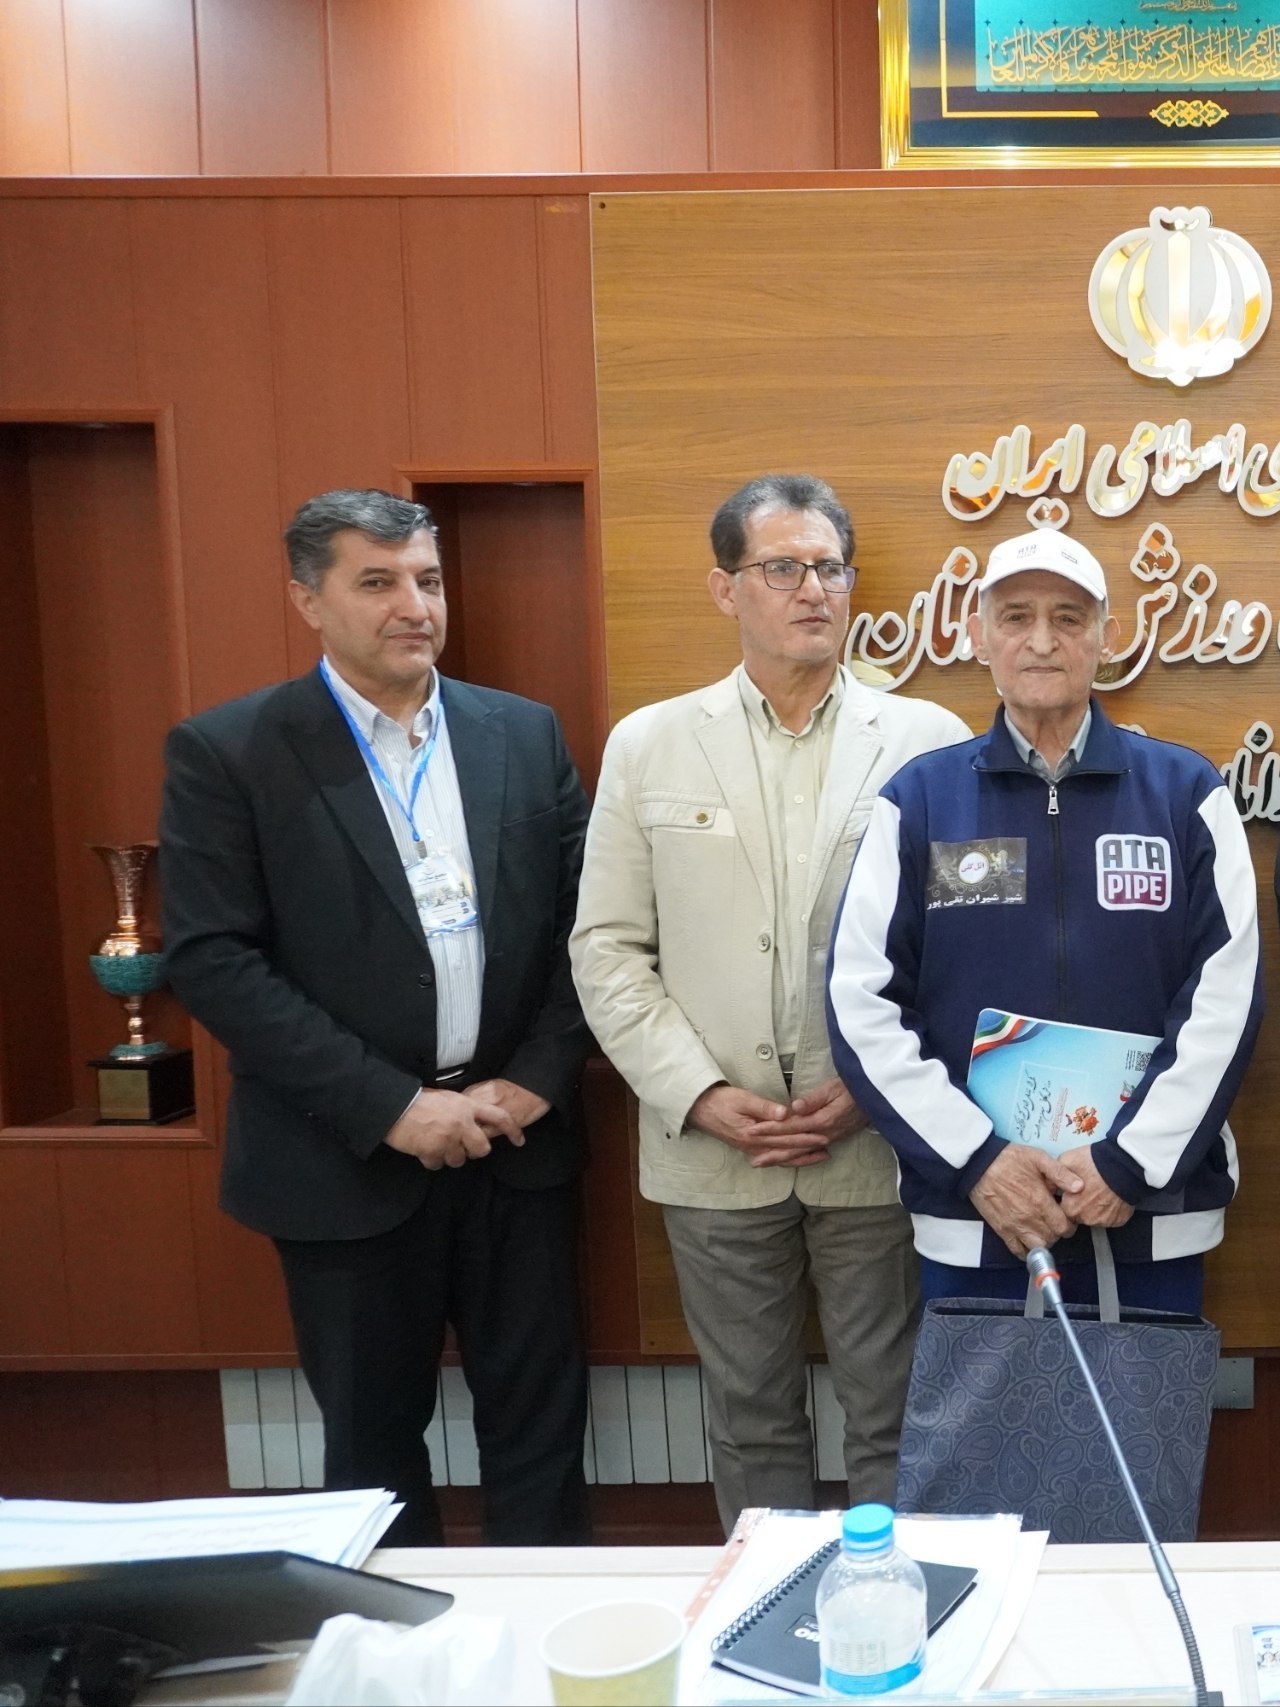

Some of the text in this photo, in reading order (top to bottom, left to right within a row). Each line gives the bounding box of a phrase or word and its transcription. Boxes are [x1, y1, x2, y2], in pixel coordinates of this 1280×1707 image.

[942, 424, 1086, 530] ایران
[1086, 418, 1247, 517] اسلامی
[1102, 839, 1167, 871] ATA
[1107, 873, 1164, 901] PIPE
